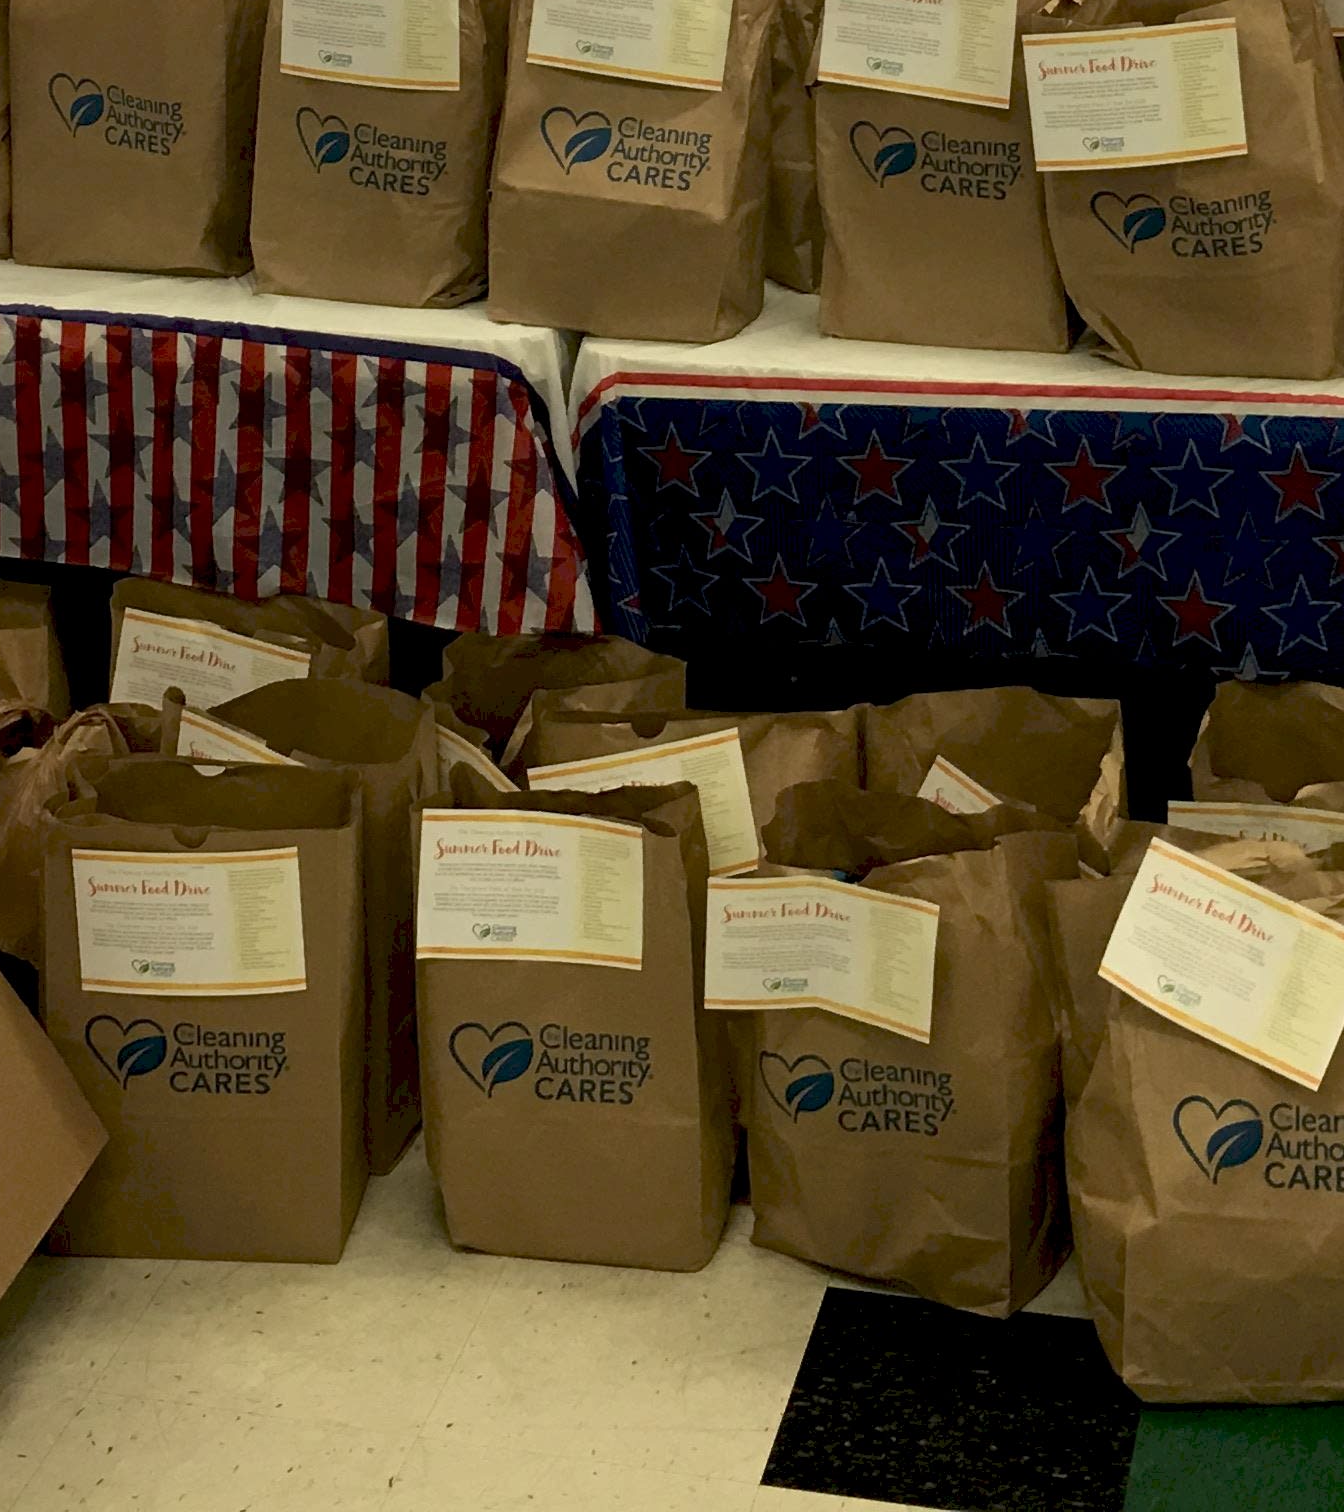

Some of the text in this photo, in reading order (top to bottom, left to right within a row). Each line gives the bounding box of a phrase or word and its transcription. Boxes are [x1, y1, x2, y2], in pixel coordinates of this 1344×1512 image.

[1038, 55, 1157, 81] Summer Food Drive
[107, 85, 182, 122] Cleaning
[106, 105, 184, 144] Authority
[618, 116, 712, 154] Cleaning
[105, 126, 170, 156] CARES
[354, 123, 447, 160] Cleaning
[922, 131, 1020, 163] Cleaning
[350, 144, 447, 181] Authority
[610, 139, 710, 177] Authority
[920, 153, 1021, 186] Authority
[349, 166, 430, 196] CARES
[607, 162, 690, 191] CARES
[920, 174, 1006, 201] CARES
[1169, 190, 1272, 216] Cleaning
[1171, 209, 1274, 237] Authority
[1172, 236, 1263, 258] CARES
[130, 634, 237, 673] Summer Food Drive
[433, 838, 562, 860] Summer Food Drive
[87, 876, 212, 897] Summer Food Drive
[720, 902, 852, 924] Summer Food Drive
[1149, 873, 1275, 944] Summer Food Drive
[173, 1022, 286, 1054] Cleaning
[539, 1023, 650, 1060] Cleaning
[170, 1046, 287, 1078] Authority
[535, 1050, 651, 1087] Authority
[840, 1058, 952, 1096] Cleaning
[169, 1071, 271, 1094] CARES
[535, 1077, 634, 1105] CARES
[838, 1085, 953, 1121] Authority
[838, 1109, 939, 1137] CARES
